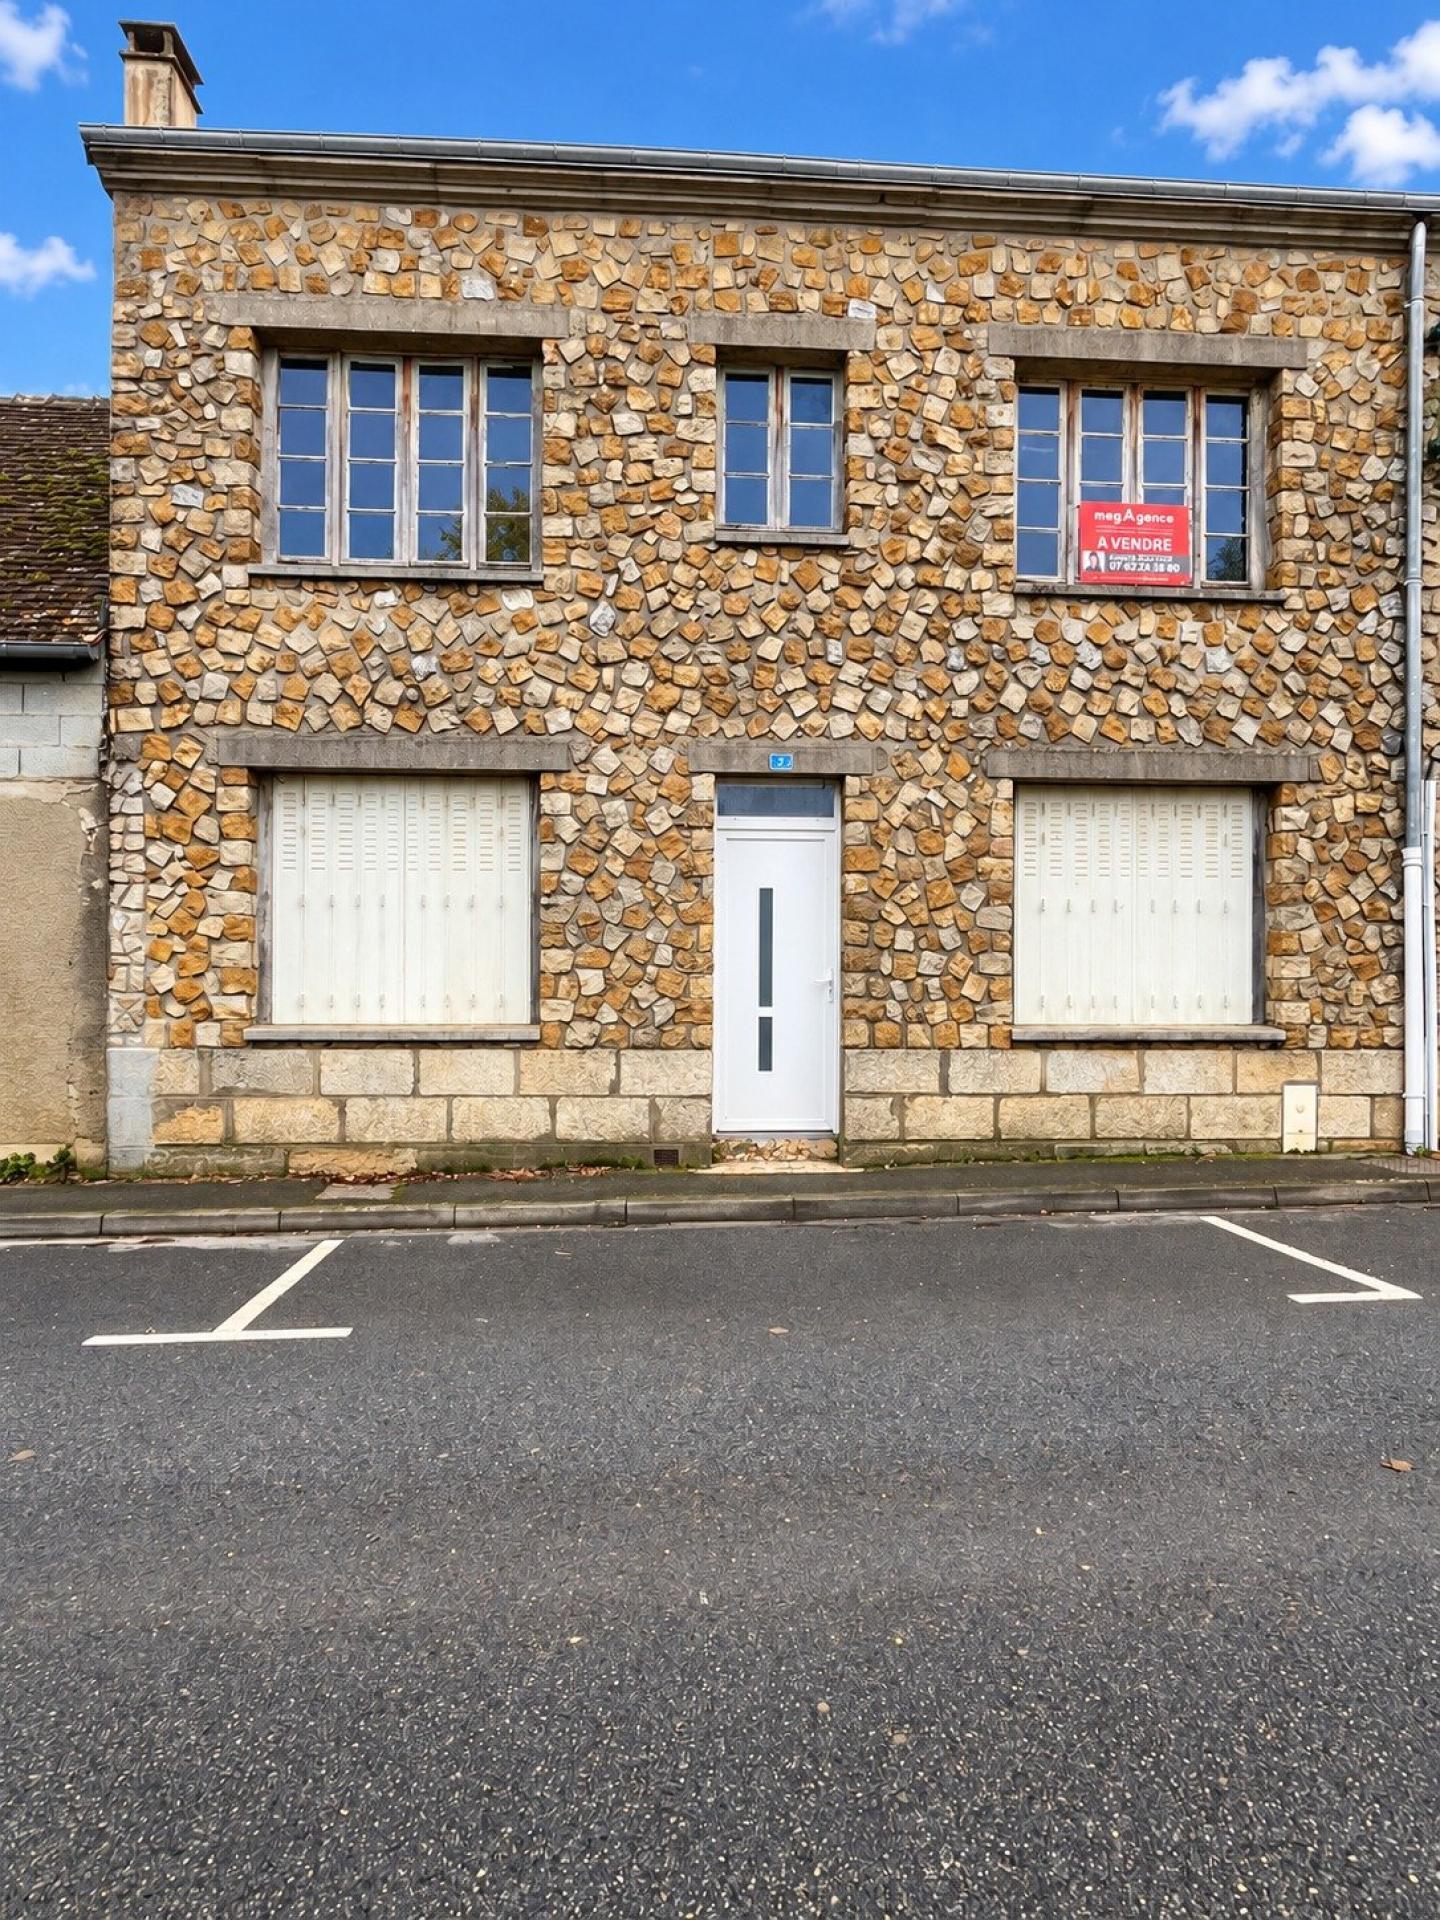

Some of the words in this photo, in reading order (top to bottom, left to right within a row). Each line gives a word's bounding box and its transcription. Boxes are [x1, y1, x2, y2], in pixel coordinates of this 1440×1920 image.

[1094, 508, 1174, 525] megAgence
[1110, 537, 1173, 552] VENDRE
[1109, 561, 1121, 571] 07
